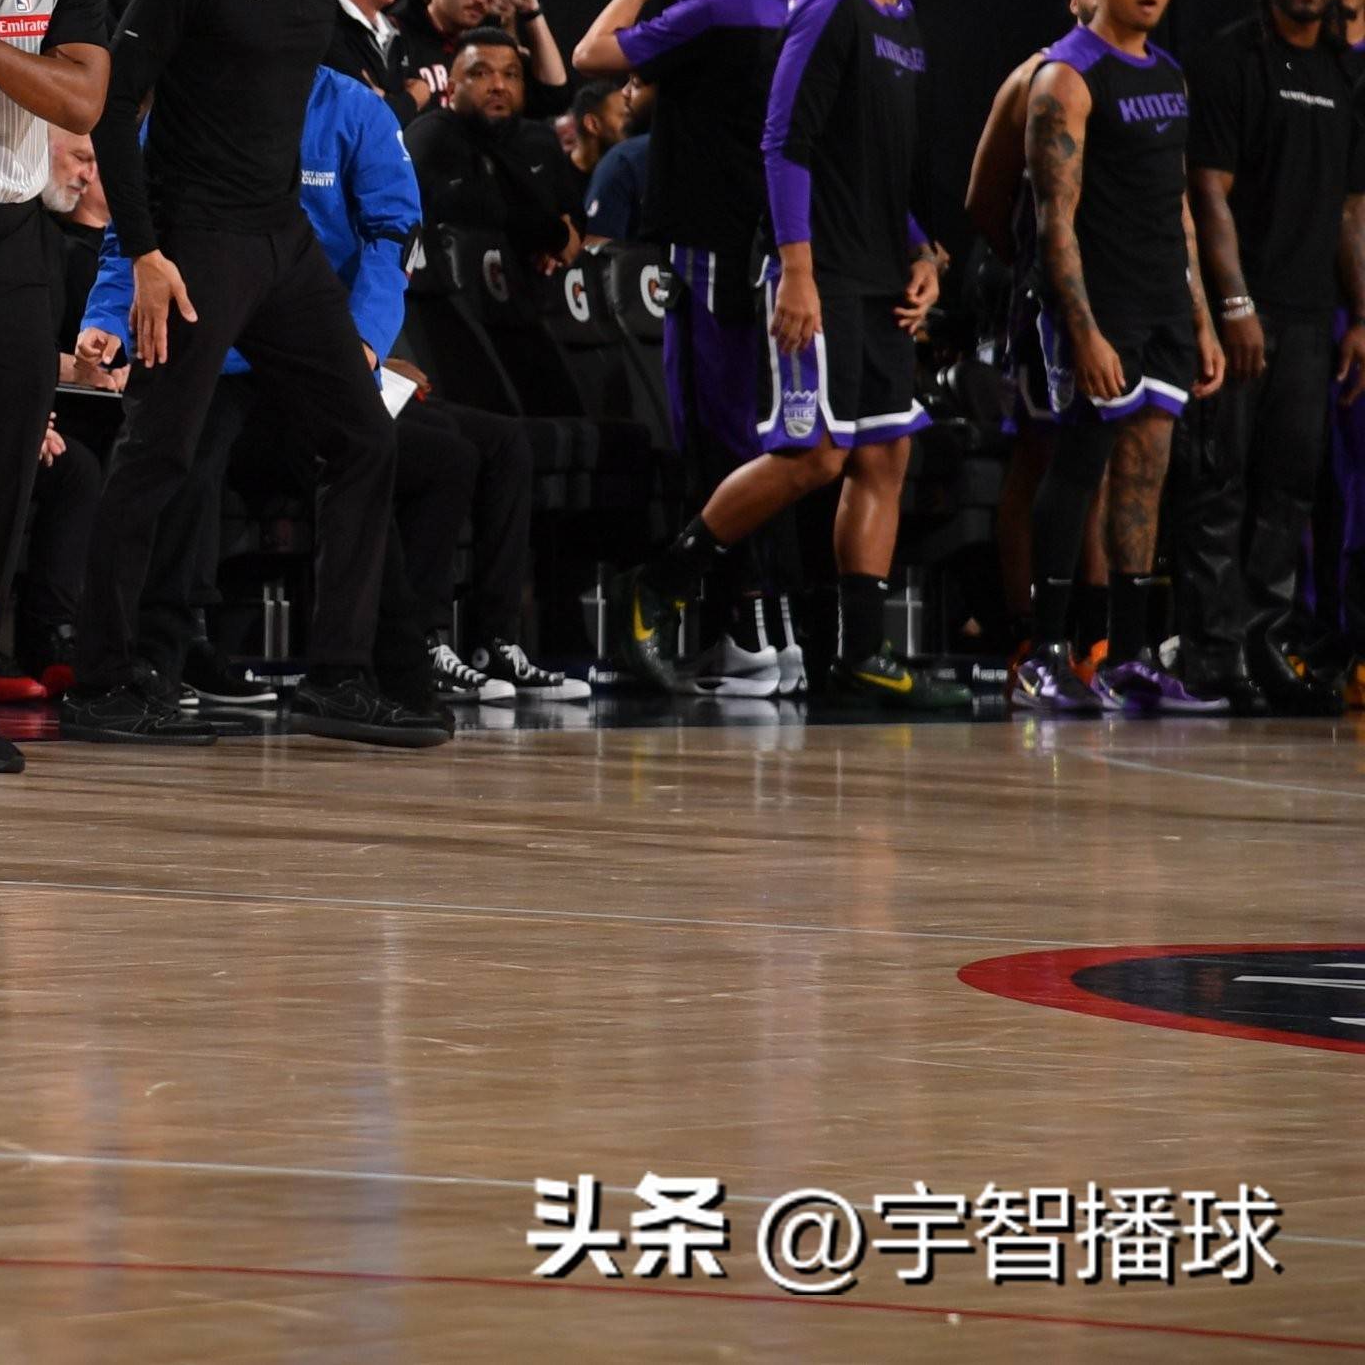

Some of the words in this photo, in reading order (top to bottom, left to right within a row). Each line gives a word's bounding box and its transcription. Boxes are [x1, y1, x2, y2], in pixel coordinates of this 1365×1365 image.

[1119, 92, 1189, 122] KINGS
[301, 176, 335, 186] CURITY
[564, 267, 590, 323] G
